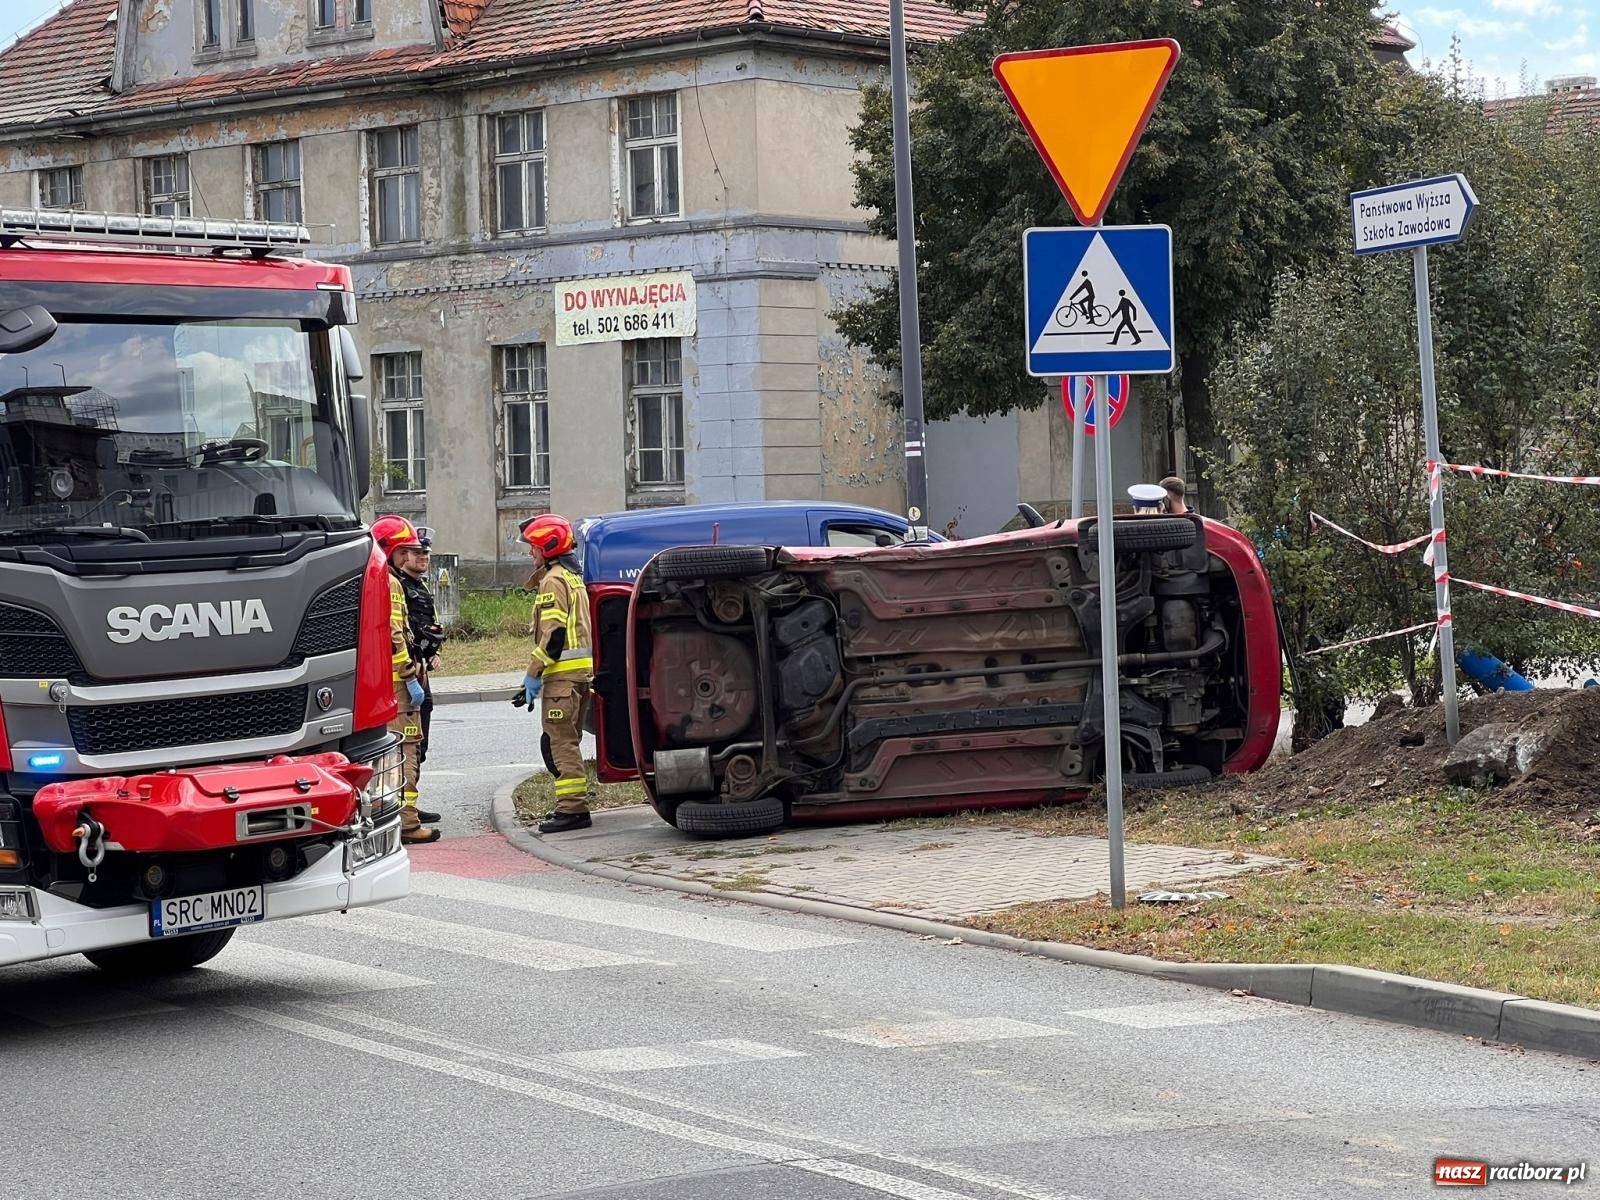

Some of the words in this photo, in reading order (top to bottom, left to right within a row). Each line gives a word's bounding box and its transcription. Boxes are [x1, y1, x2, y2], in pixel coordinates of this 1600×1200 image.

[1360, 198, 1412, 218] Państwowa
[1415, 191, 1451, 213] Wyższa
[1363, 222, 1394, 242] Szkoła
[1397, 216, 1451, 236] Zawodowa
[564, 291, 587, 311] DO
[591, 283, 687, 309] WYNAJĘCIA
[573, 319, 594, 336] tel.
[598, 316, 620, 333] 502
[624, 314, 648, 331] 686
[652, 312, 675, 330] 411
[542, 594, 553, 602] PSP
[106, 598, 273, 644] SCANIA
[406, 727, 417, 735] PSP
[166, 897, 203, 926] SRC
[211, 889, 257, 919] MN02
[153, 919, 161, 927] PL
